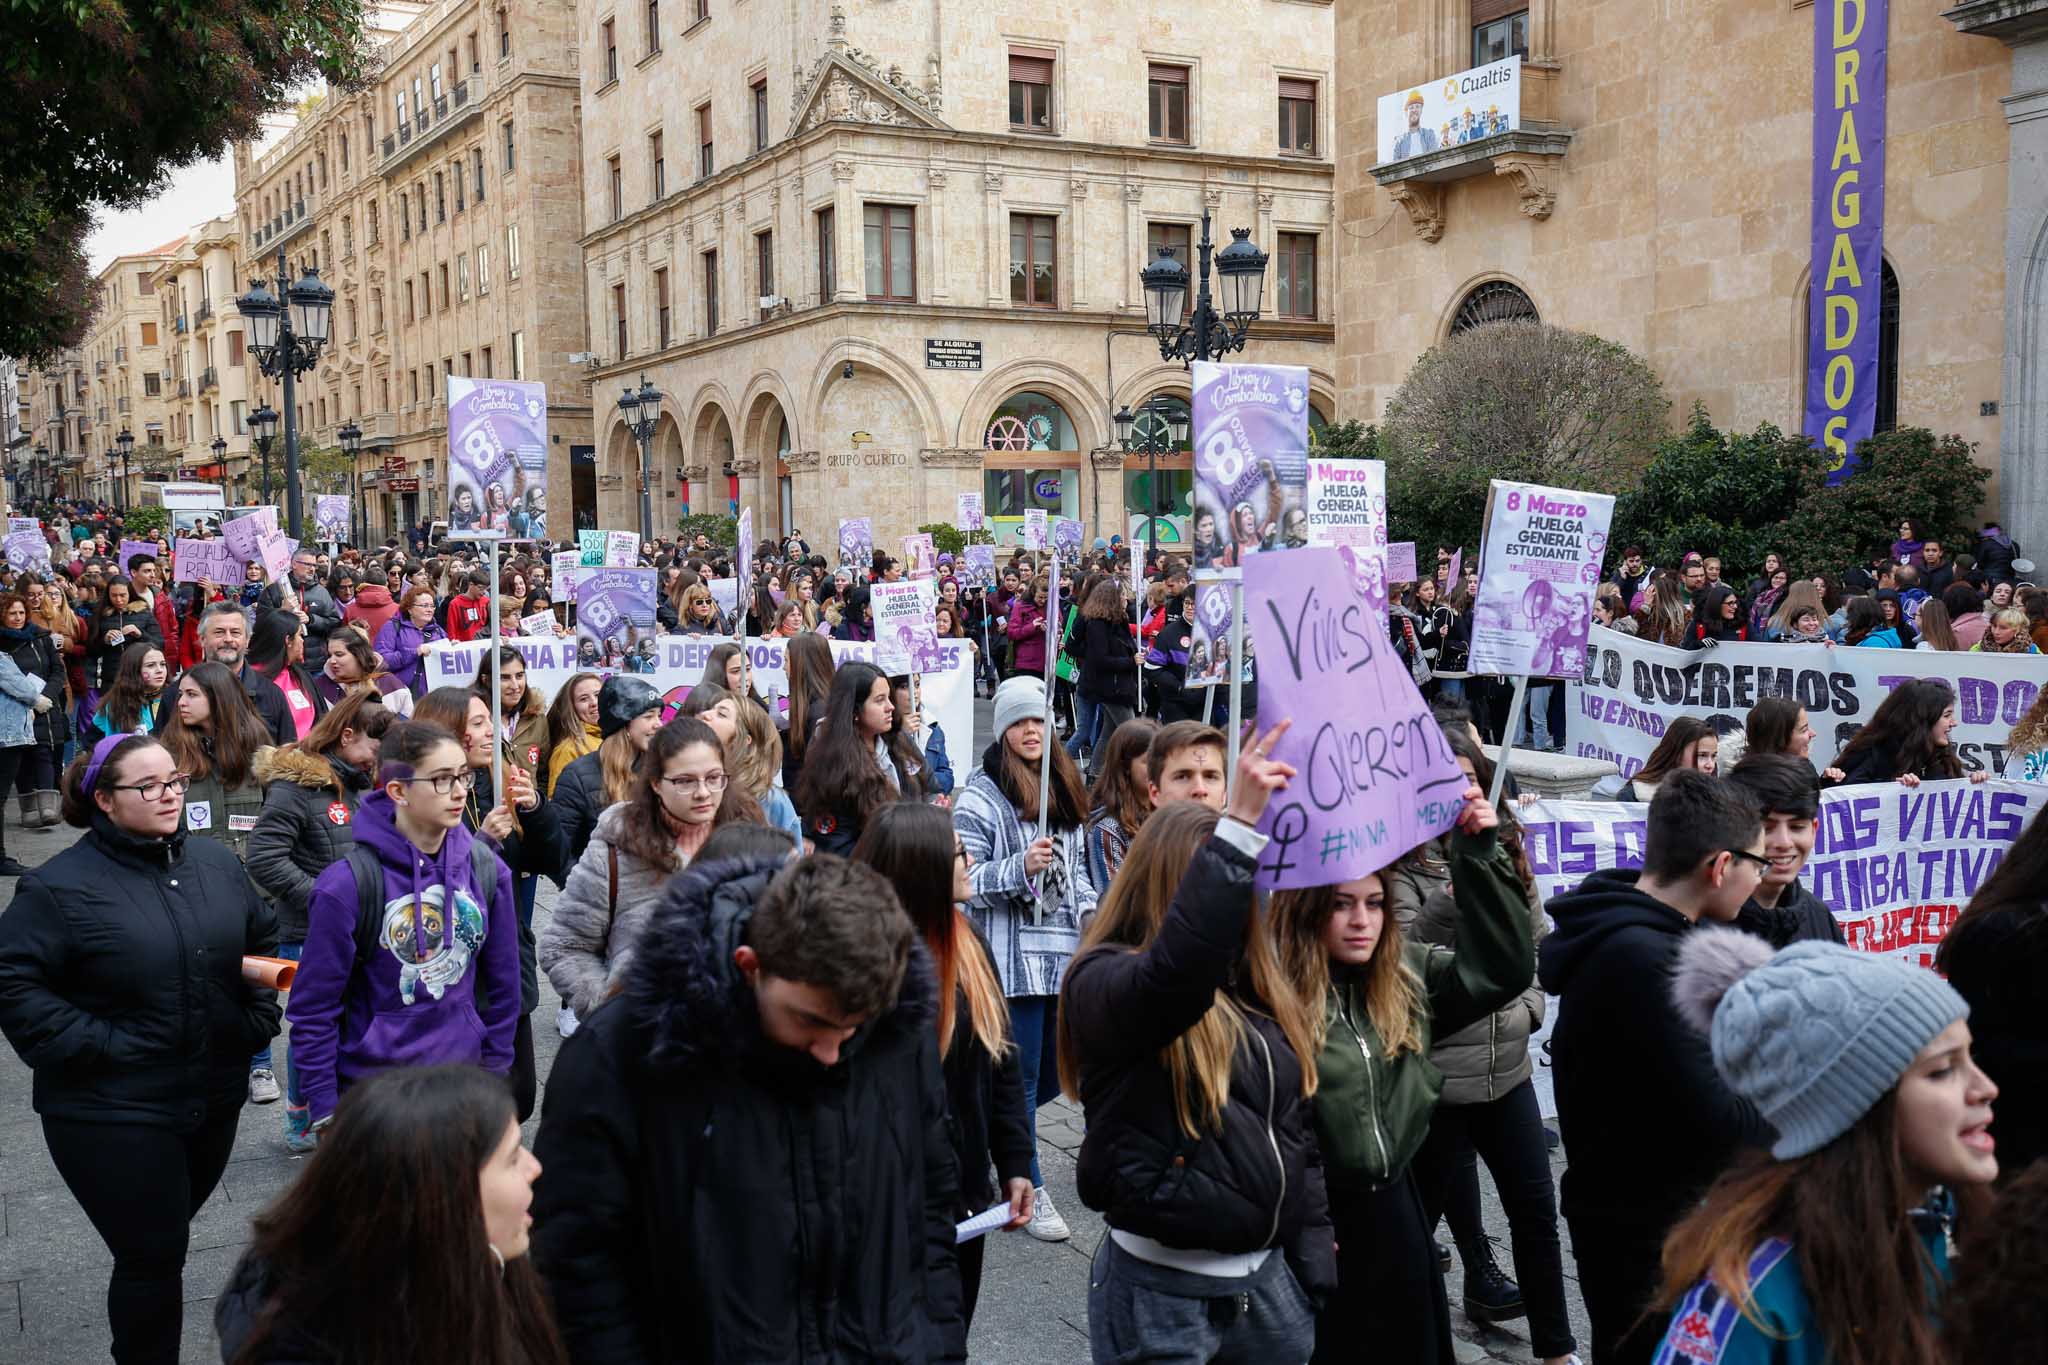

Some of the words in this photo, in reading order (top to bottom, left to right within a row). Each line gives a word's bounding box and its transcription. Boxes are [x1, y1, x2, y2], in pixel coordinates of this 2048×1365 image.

[1461, 66, 1511, 94] Cualtis
[1210, 384, 1280, 412] Combativas
[464, 429, 495, 471] 8
[1204, 429, 1244, 487] 8
[826, 454, 861, 467] GRUPO
[864, 454, 906, 466] CURTO
[1317, 463, 1367, 482] Marzo
[1323, 484, 1368, 498] HUELGA
[1317, 499, 1369, 512] GENERAL
[1506, 491, 1521, 512] 8
[1526, 494, 1588, 519] Marzo
[1309, 513, 1371, 525] ESTUDIANTIL
[1527, 515, 1584, 534] HUELGA
[1517, 530, 1582, 549] GENERAL
[177, 542, 233, 561] IGUALDA
[1505, 544, 1580, 562] ESTUDIANTIL
[185, 561, 219, 581] REAL
[875, 586, 883, 597] 8
[885, 585, 918, 596] Marzo
[888, 593, 920, 604] HUELGA
[587, 600, 612, 628] 8
[880, 609, 922, 618] ESTUDIANTIL
[885, 601, 921, 611] GENERAL
[1205, 591, 1227, 627] 8
[441, 650, 474, 675] EN
[1632, 657, 1861, 717] QUEREMOS
[1877, 675, 2040, 726] TDO
[1523, 821, 1597, 875] OS
[1899, 788, 2028, 842] VIVAS
